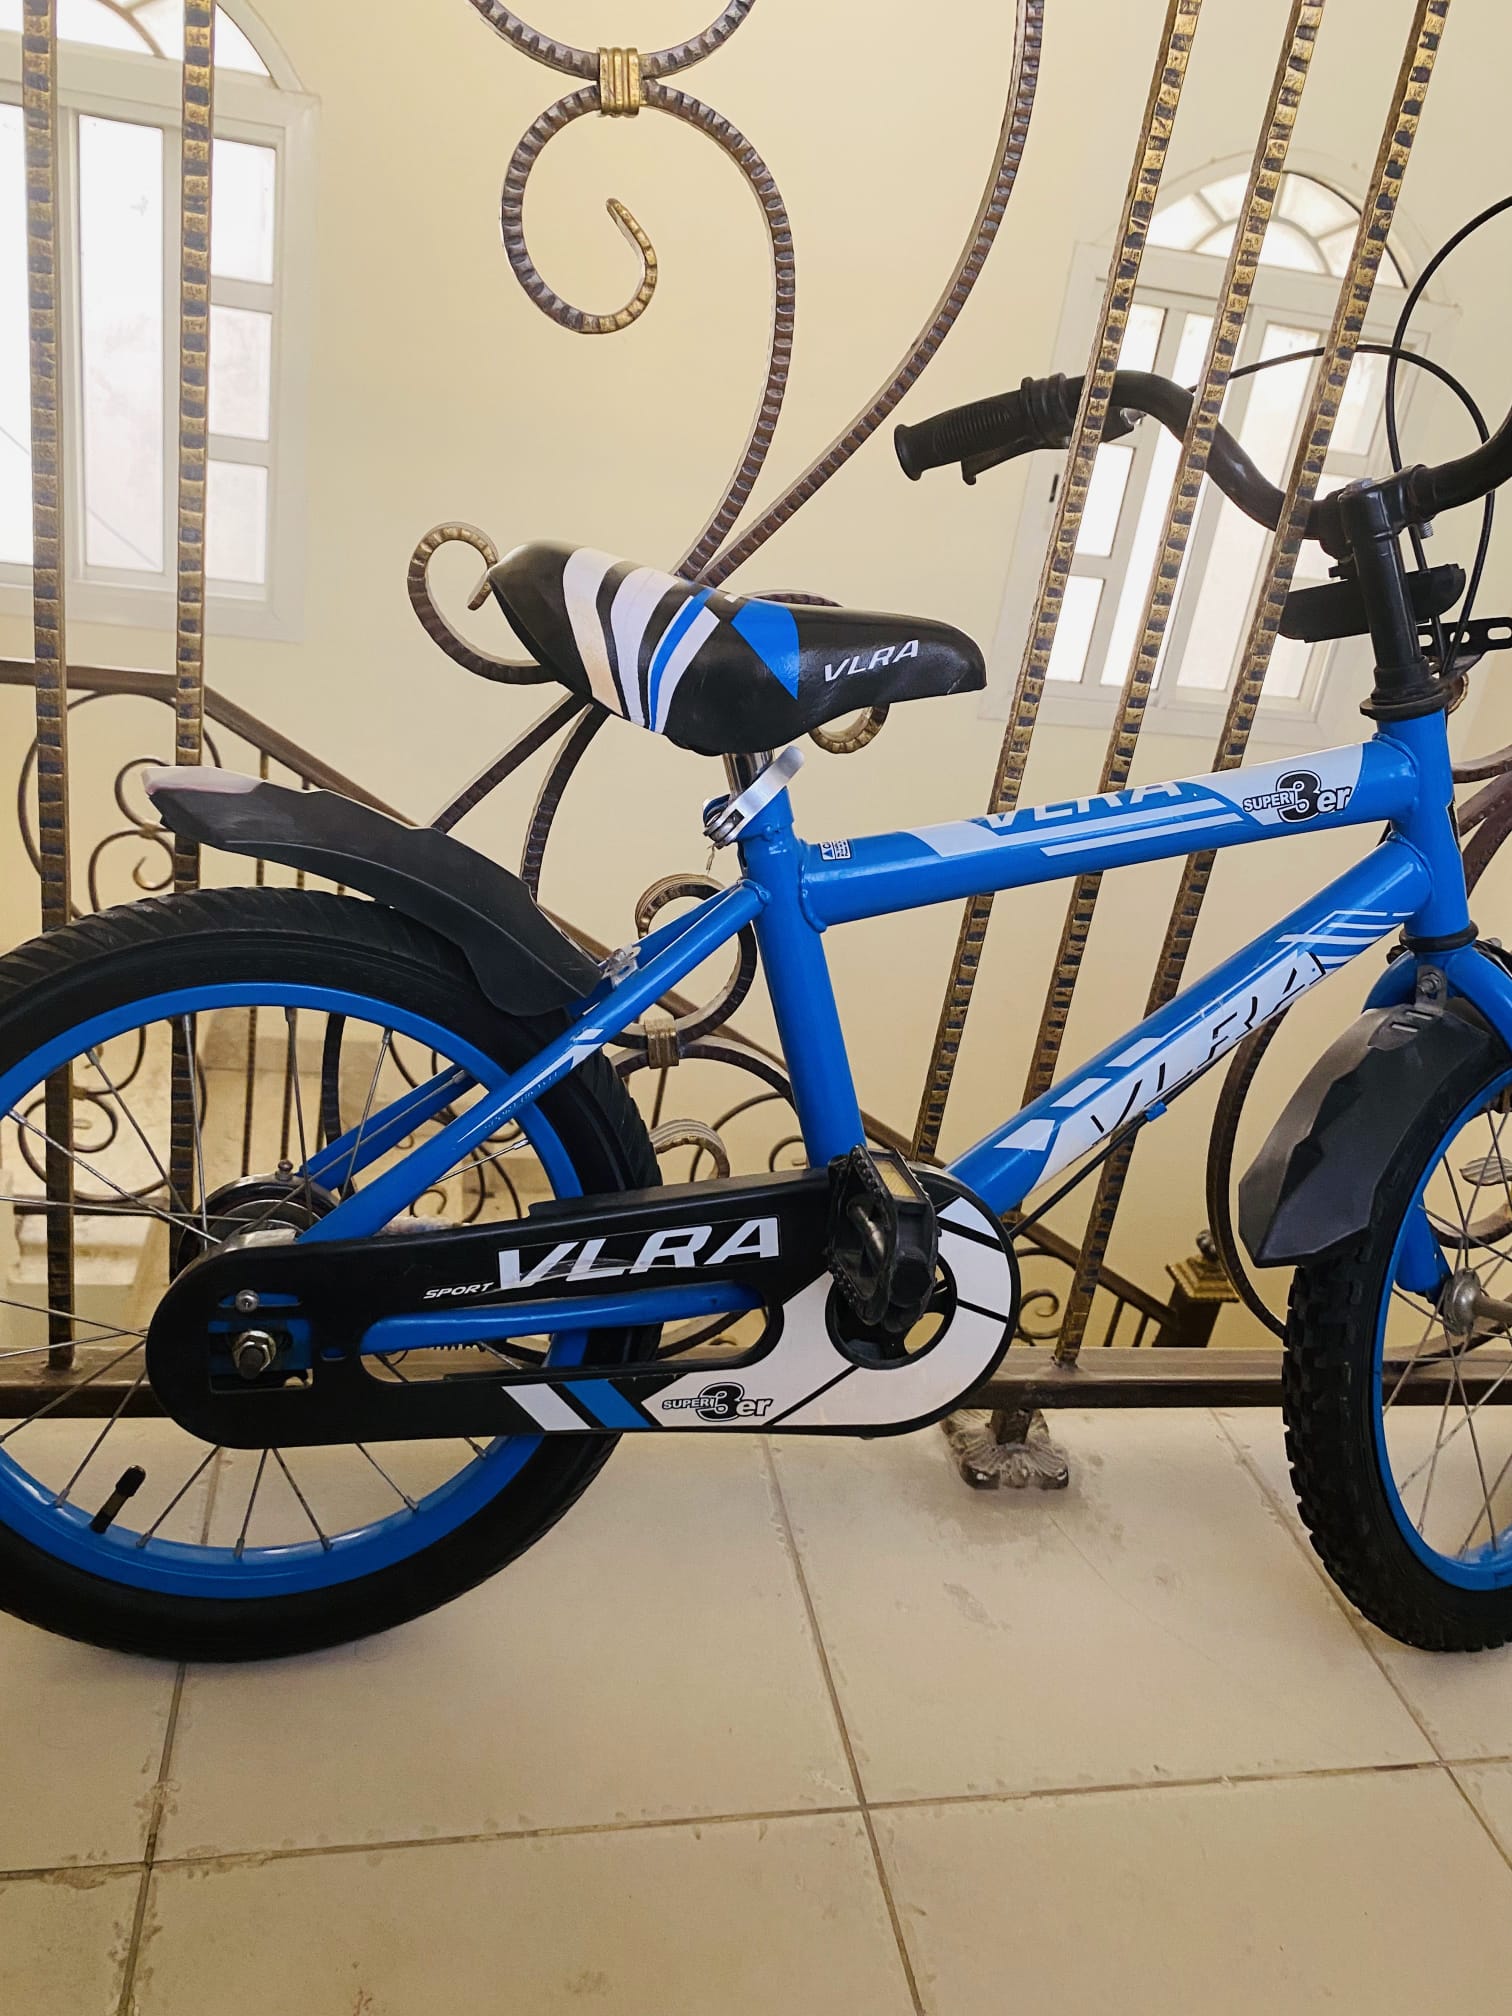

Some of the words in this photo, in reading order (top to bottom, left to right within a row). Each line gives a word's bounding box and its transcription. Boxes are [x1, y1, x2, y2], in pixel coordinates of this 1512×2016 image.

[824, 639, 919, 682] VLRA
[1080, 950, 1326, 1146] VLRA
[423, 1282, 494, 1299] SPORT
[499, 1217, 780, 1290] VLRA
